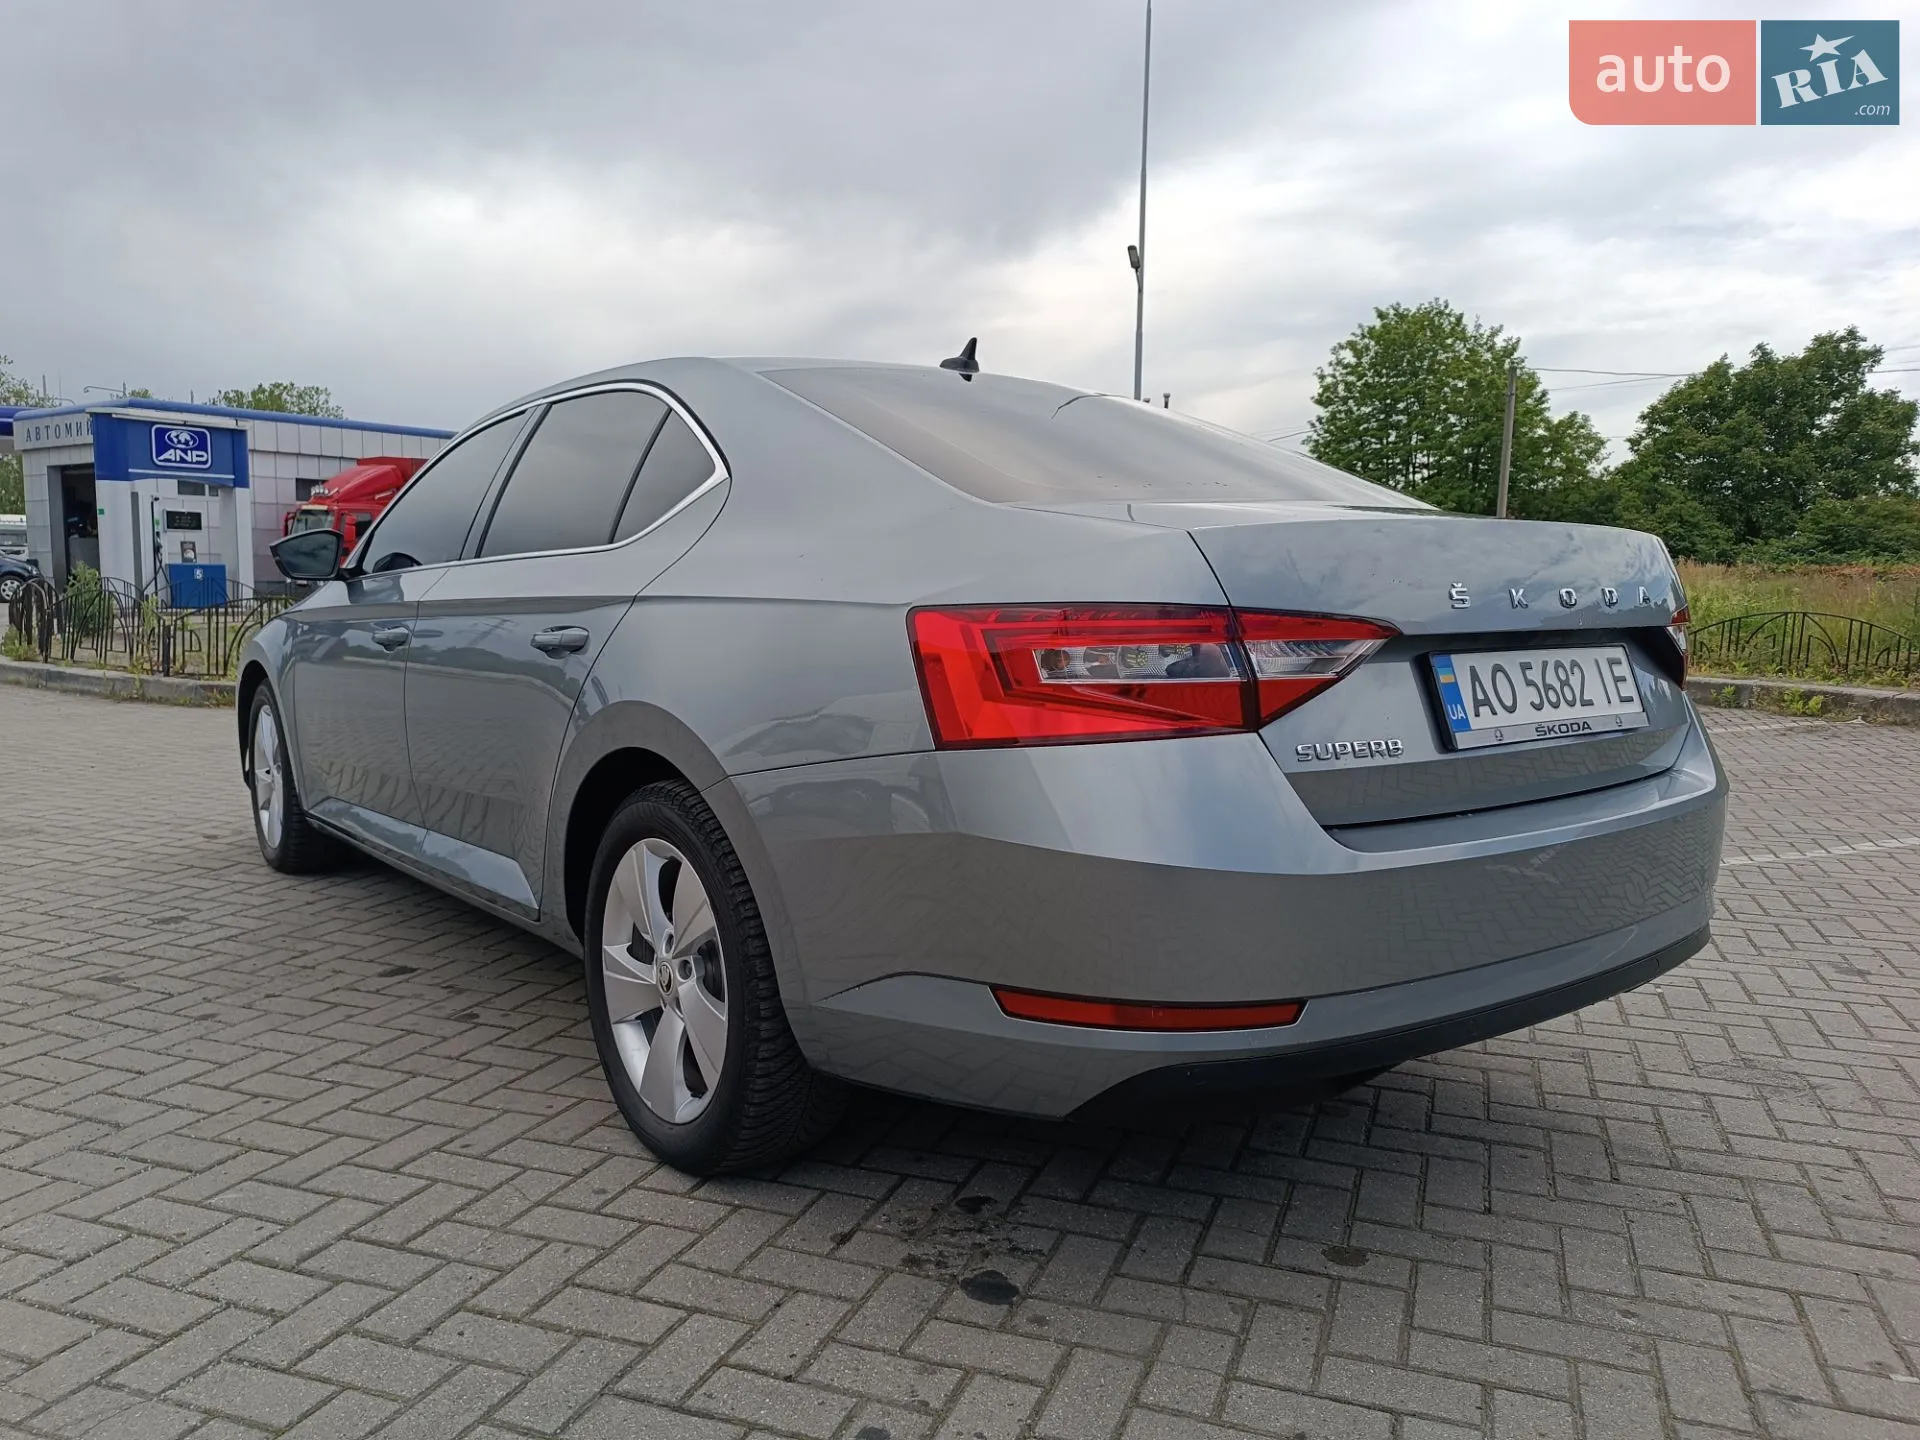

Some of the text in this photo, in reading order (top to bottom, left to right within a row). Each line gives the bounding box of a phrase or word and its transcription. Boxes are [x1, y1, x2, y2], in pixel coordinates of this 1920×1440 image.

[157, 448, 208, 463] ANP
[1468, 656, 1635, 718] AO 5682 IE
[1449, 703, 1467, 721] UA
[1535, 720, 1593, 737] ŠKODA
[1296, 739, 1404, 762] SUPERB
